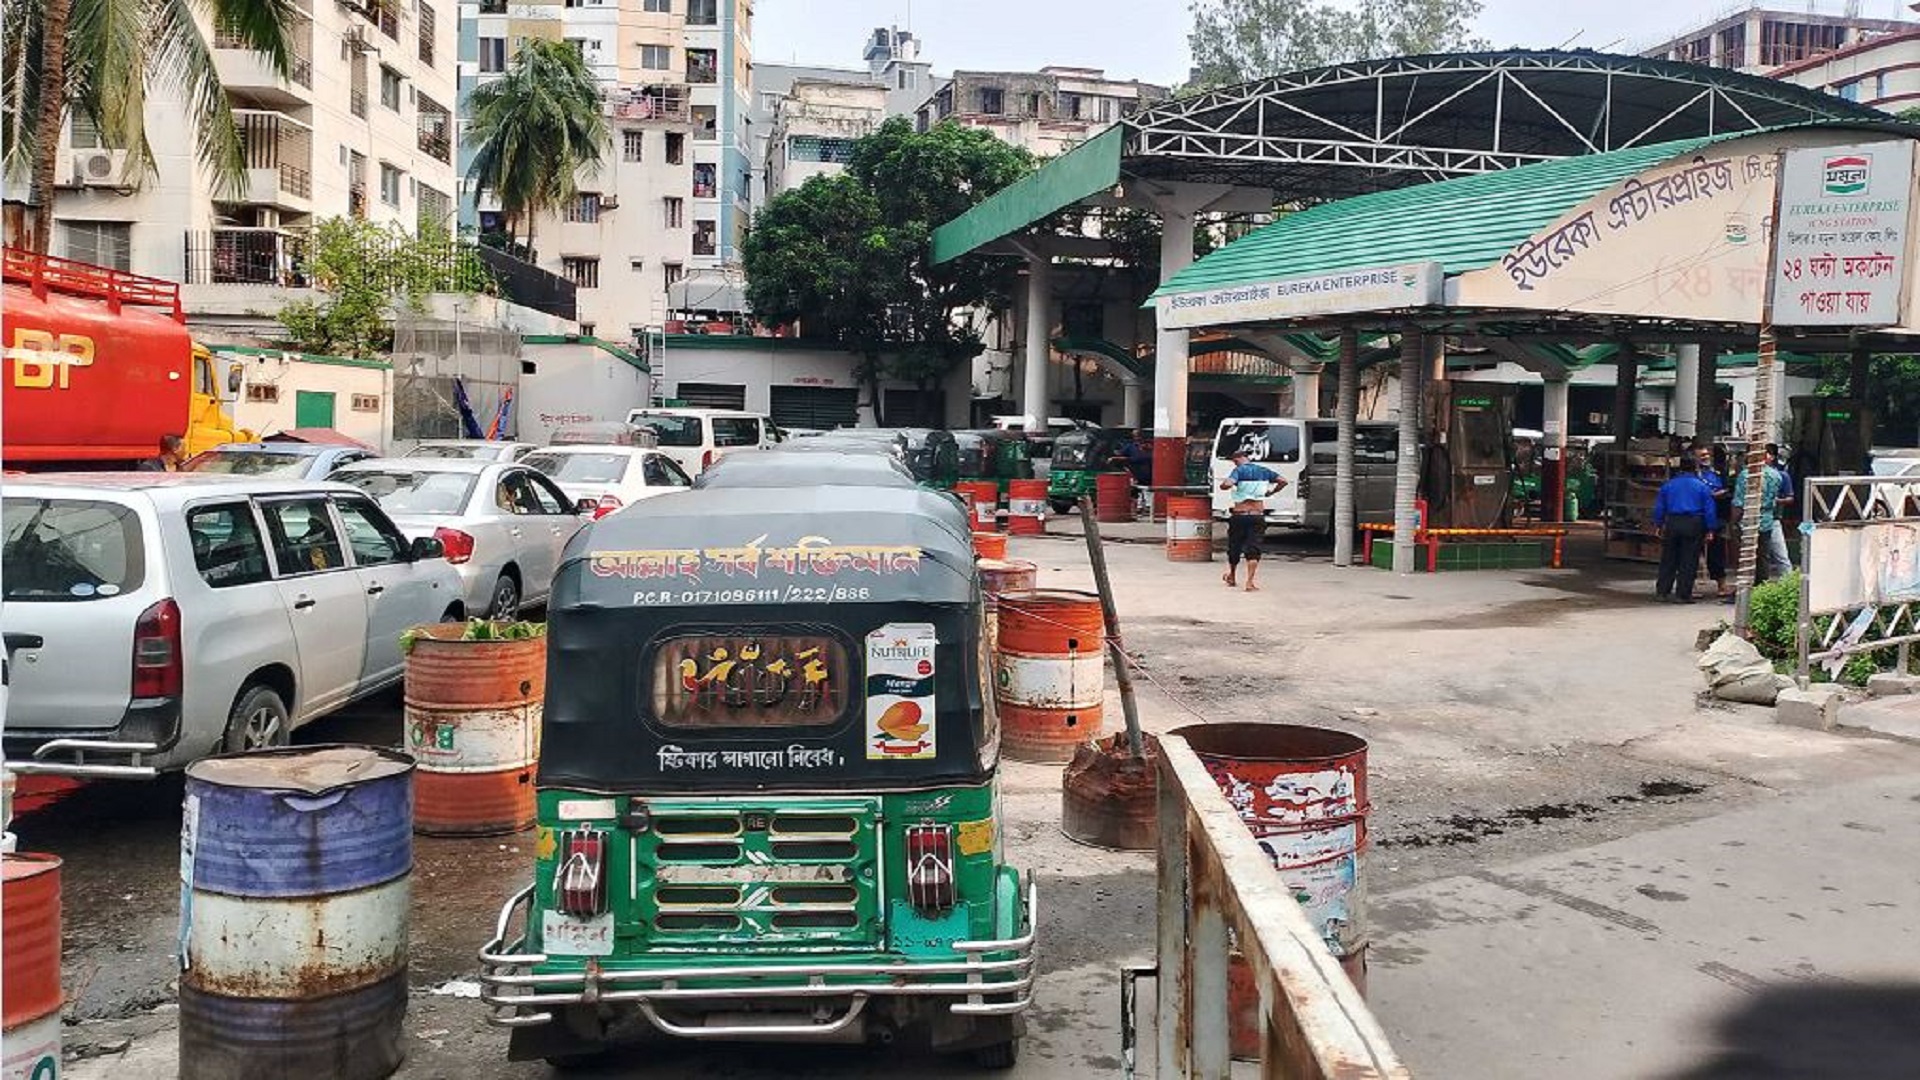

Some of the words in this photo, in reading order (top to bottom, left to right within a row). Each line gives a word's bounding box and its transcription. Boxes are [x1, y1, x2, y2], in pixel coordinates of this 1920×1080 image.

[1833, 199, 1900, 214] ENTERPRISE
[1502, 210, 1600, 291] ইউরেকা
[1607, 155, 1734, 231] এন্টারপ্রাইজ
[1783, 258, 1802, 281] ২৪
[1843, 252, 1895, 279] অকটেন
[1277, 278, 1321, 297] EUREKA
[1323, 270, 1398, 291] ENTERPRISE
[1800, 292, 1841, 314] পাওয়া
[1846, 292, 1871, 313] যায়
[14, 327, 95, 389] BP
[871, 646, 930, 659] NUTRILIFE
